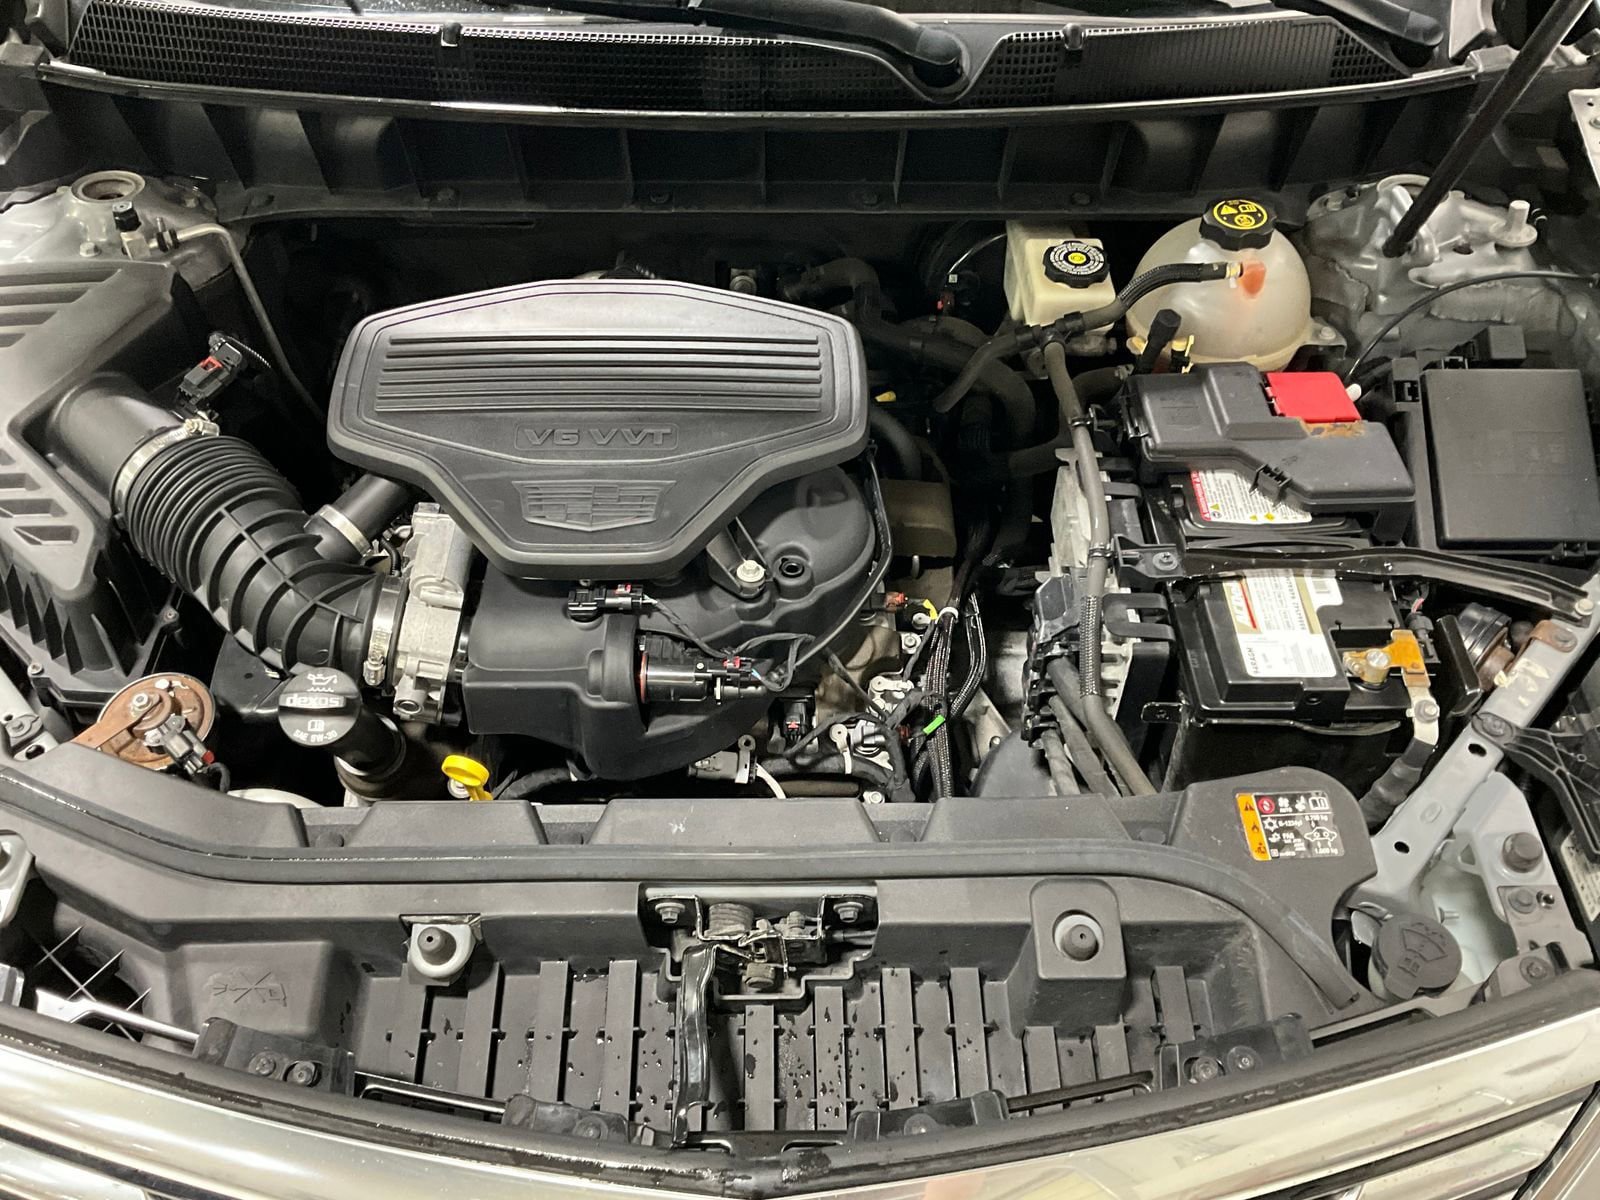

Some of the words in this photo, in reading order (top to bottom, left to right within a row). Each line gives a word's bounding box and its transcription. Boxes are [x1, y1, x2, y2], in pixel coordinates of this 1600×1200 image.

[523, 428, 579, 446] V6
[588, 428, 672, 446] VVT
[285, 692, 341, 707] dexos
[293, 729, 309, 741] SAE
